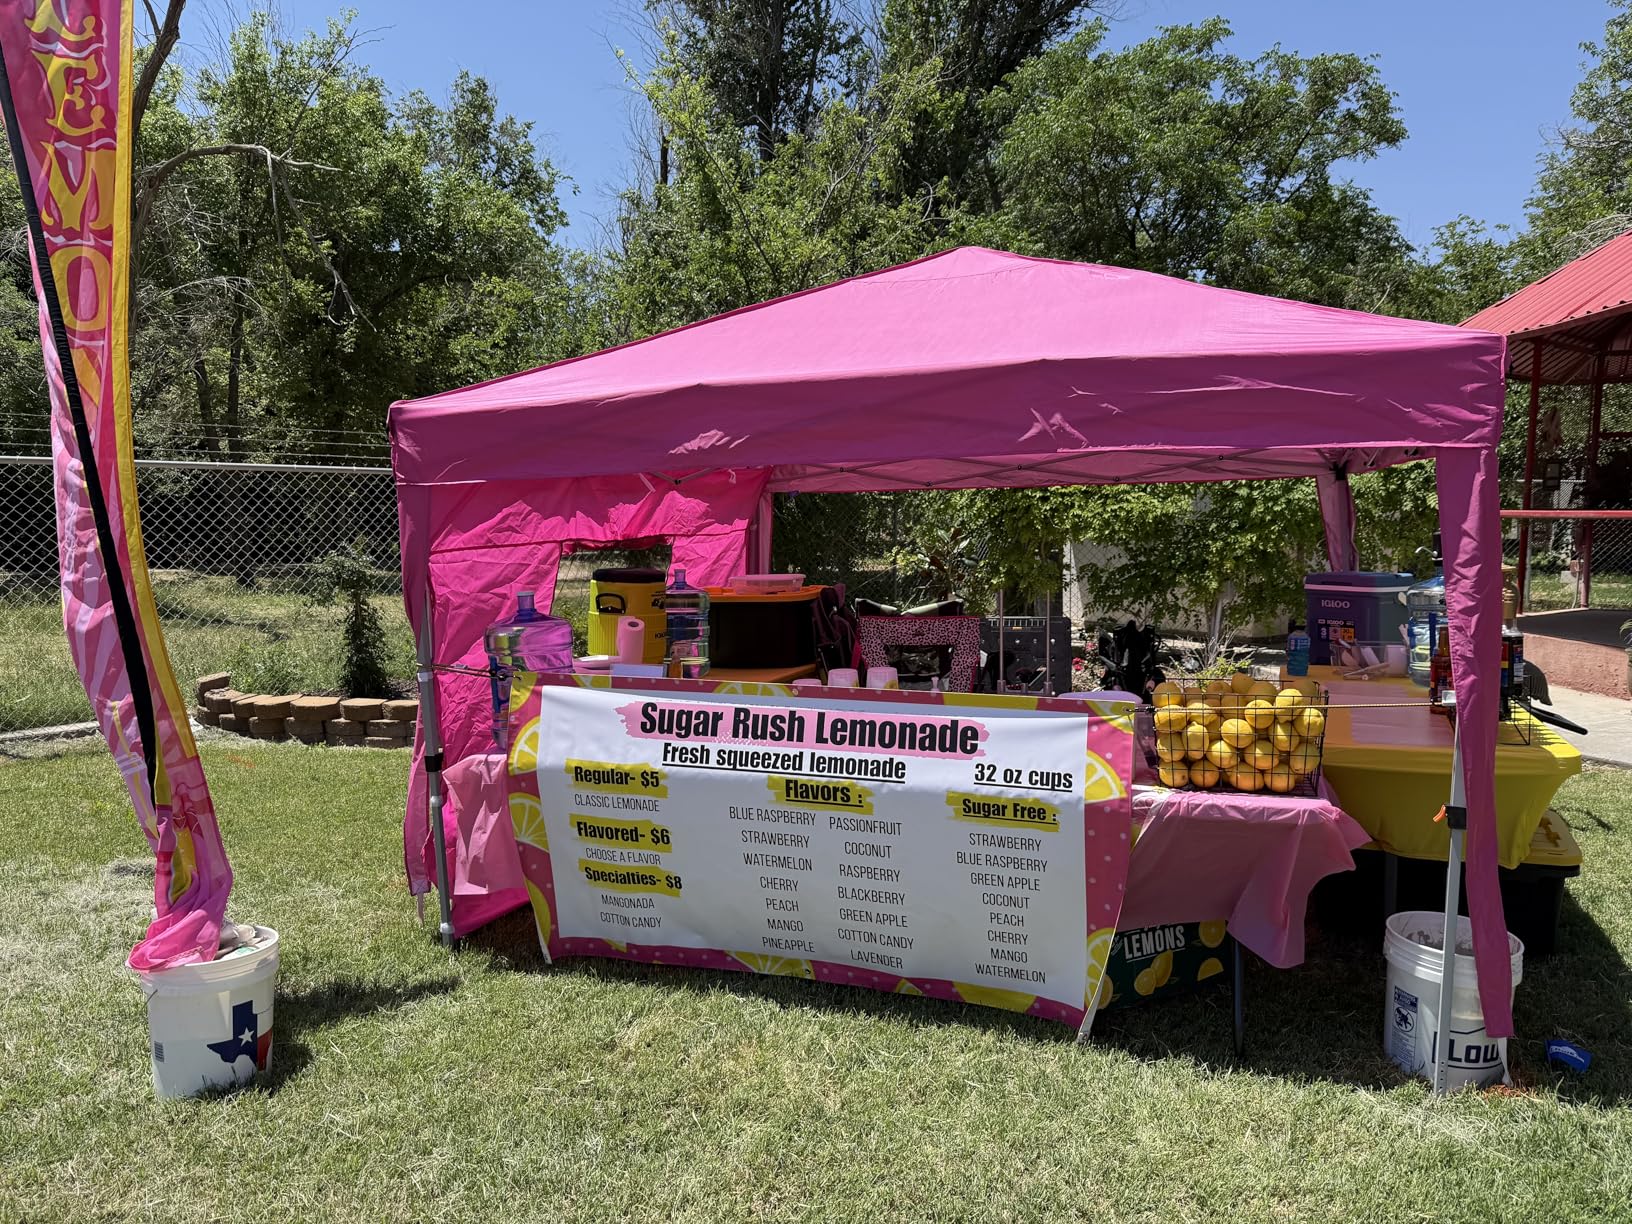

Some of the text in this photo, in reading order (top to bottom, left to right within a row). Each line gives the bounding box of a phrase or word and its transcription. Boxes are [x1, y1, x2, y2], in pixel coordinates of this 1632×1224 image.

[640, 702, 979, 755] Sugar Rush Lemonade
[662, 743, 906, 780] Fresh squeezed lemonade
[574, 766, 660, 788] Regular- $5
[974, 764, 1073, 790] 32 oz cups
[785, 780, 850, 801] Flavors
[574, 794, 660, 812] CLASSIC LEMONADE
[962, 799, 1008, 818] Sugar
[1012, 803, 1047, 820] Free
[729, 806, 816, 826] BLUE RASPBERRY
[829, 816, 902, 836] PASSIONFRUIT
[577, 821, 670, 846] Flavored- $6
[740, 830, 810, 848] STRAWBERRY
[969, 833, 1042, 852] STRAWBERRY
[585, 848, 661, 865] CHOOSE A FLAVOR
[844, 842, 892, 858] COCONUT
[743, 852, 812, 872] WATERMELON
[956, 852, 1048, 872] BLUE RASPBERRY
[584, 866, 682, 890] Specialties- $8
[839, 864, 900, 883] RASPBERRY
[970, 872, 1040, 892] GREEN APPLE
[760, 876, 798, 892] CHERRY
[601, 894, 655, 909] MANGONADA
[766, 898, 799, 912] PEACH
[838, 886, 906, 906] BLACKBERRY
[982, 892, 1030, 910] COCONUT
[600, 912, 662, 928] COTTON CANDY
[766, 918, 804, 932] MANGO
[839, 908, 908, 928] GREEN APPLE
[990, 912, 1024, 927] PEACH
[762, 936, 815, 952] PINEAPPLE
[838, 928, 914, 950] COTTON CANDY
[987, 930, 1028, 946] CHERRY
[1123, 924, 1186, 960] LEMONS
[850, 950, 904, 969] LAVENDER
[990, 948, 1028, 963] MANGO
[974, 964, 1046, 984] WATERMELON
